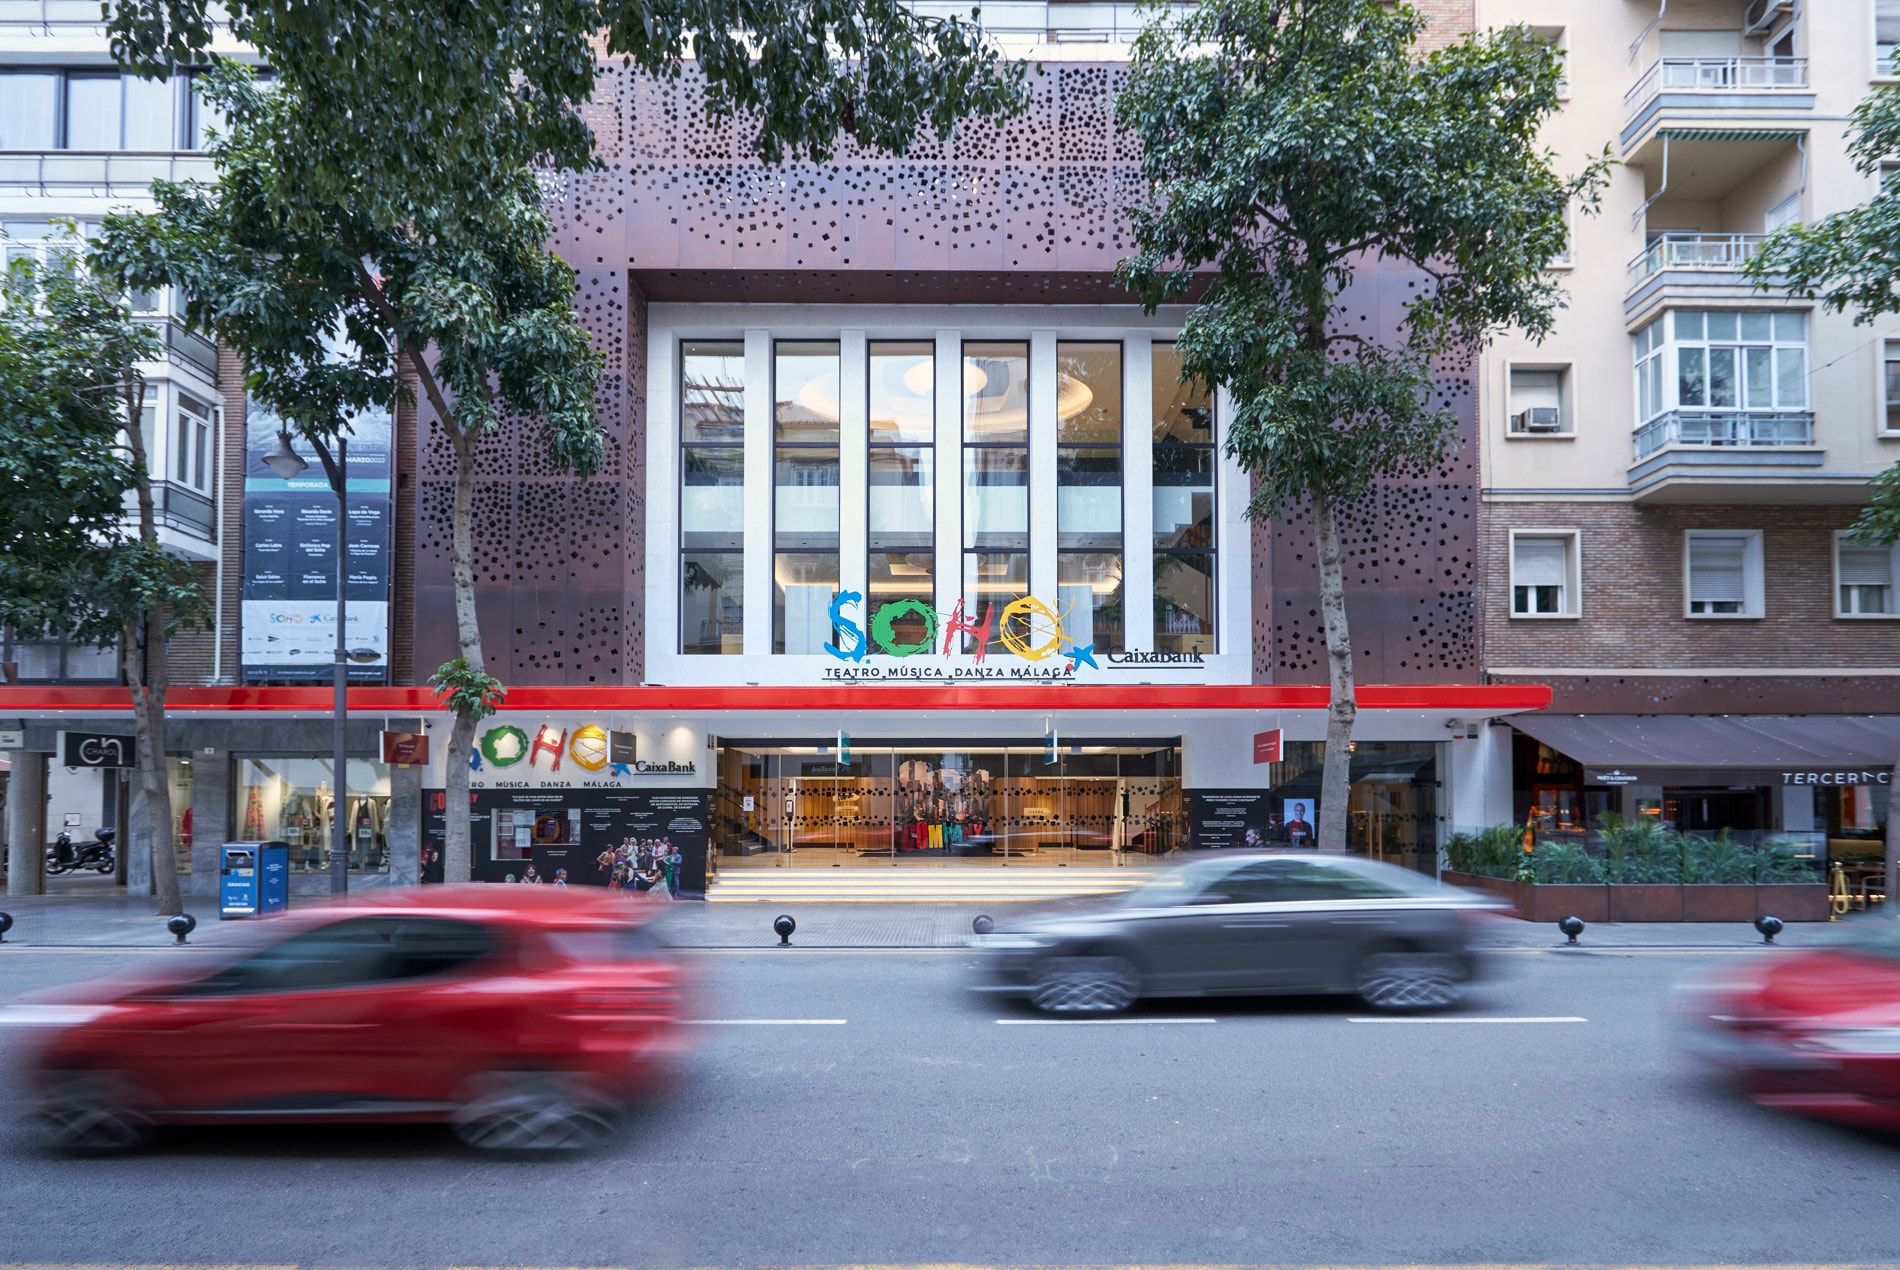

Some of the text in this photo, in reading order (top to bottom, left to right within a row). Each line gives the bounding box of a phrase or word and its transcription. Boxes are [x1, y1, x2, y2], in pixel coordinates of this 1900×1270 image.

[270, 613, 304, 624] SOHO
[824, 589, 1072, 664] SOHO
[1107, 645, 1205, 664] CaixaBank
[825, 664, 1073, 677] TEATRO MÚSICA DANZA MÁLAGA
[86, 748, 118, 756] CHAROL
[469, 723, 610, 773] OHO
[635, 760, 696, 772] CaixaBank
[903, 821, 983, 850] COMPANY
